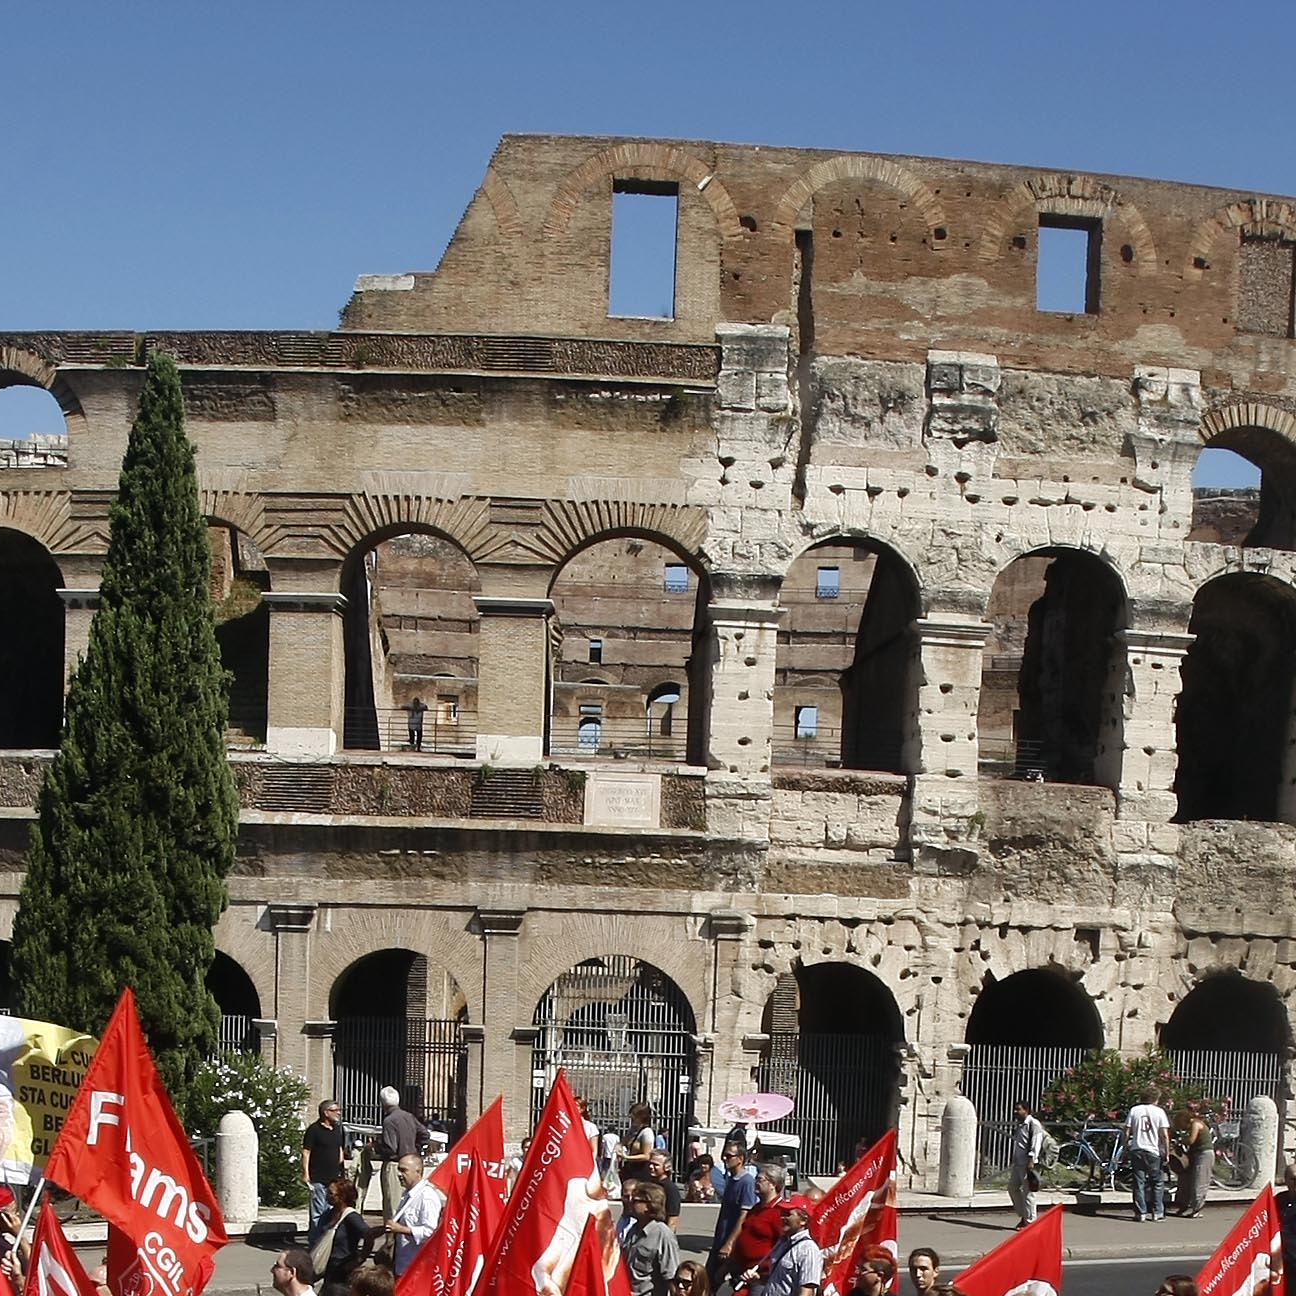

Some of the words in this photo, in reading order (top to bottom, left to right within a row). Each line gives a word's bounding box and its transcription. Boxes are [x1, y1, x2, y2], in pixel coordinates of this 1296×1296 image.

[72, 1048, 98, 1069] CU
[30, 1063, 86, 1088] BERLU
[20, 1085, 46, 1106] STA
[144, 1231, 184, 1293] CGIL
